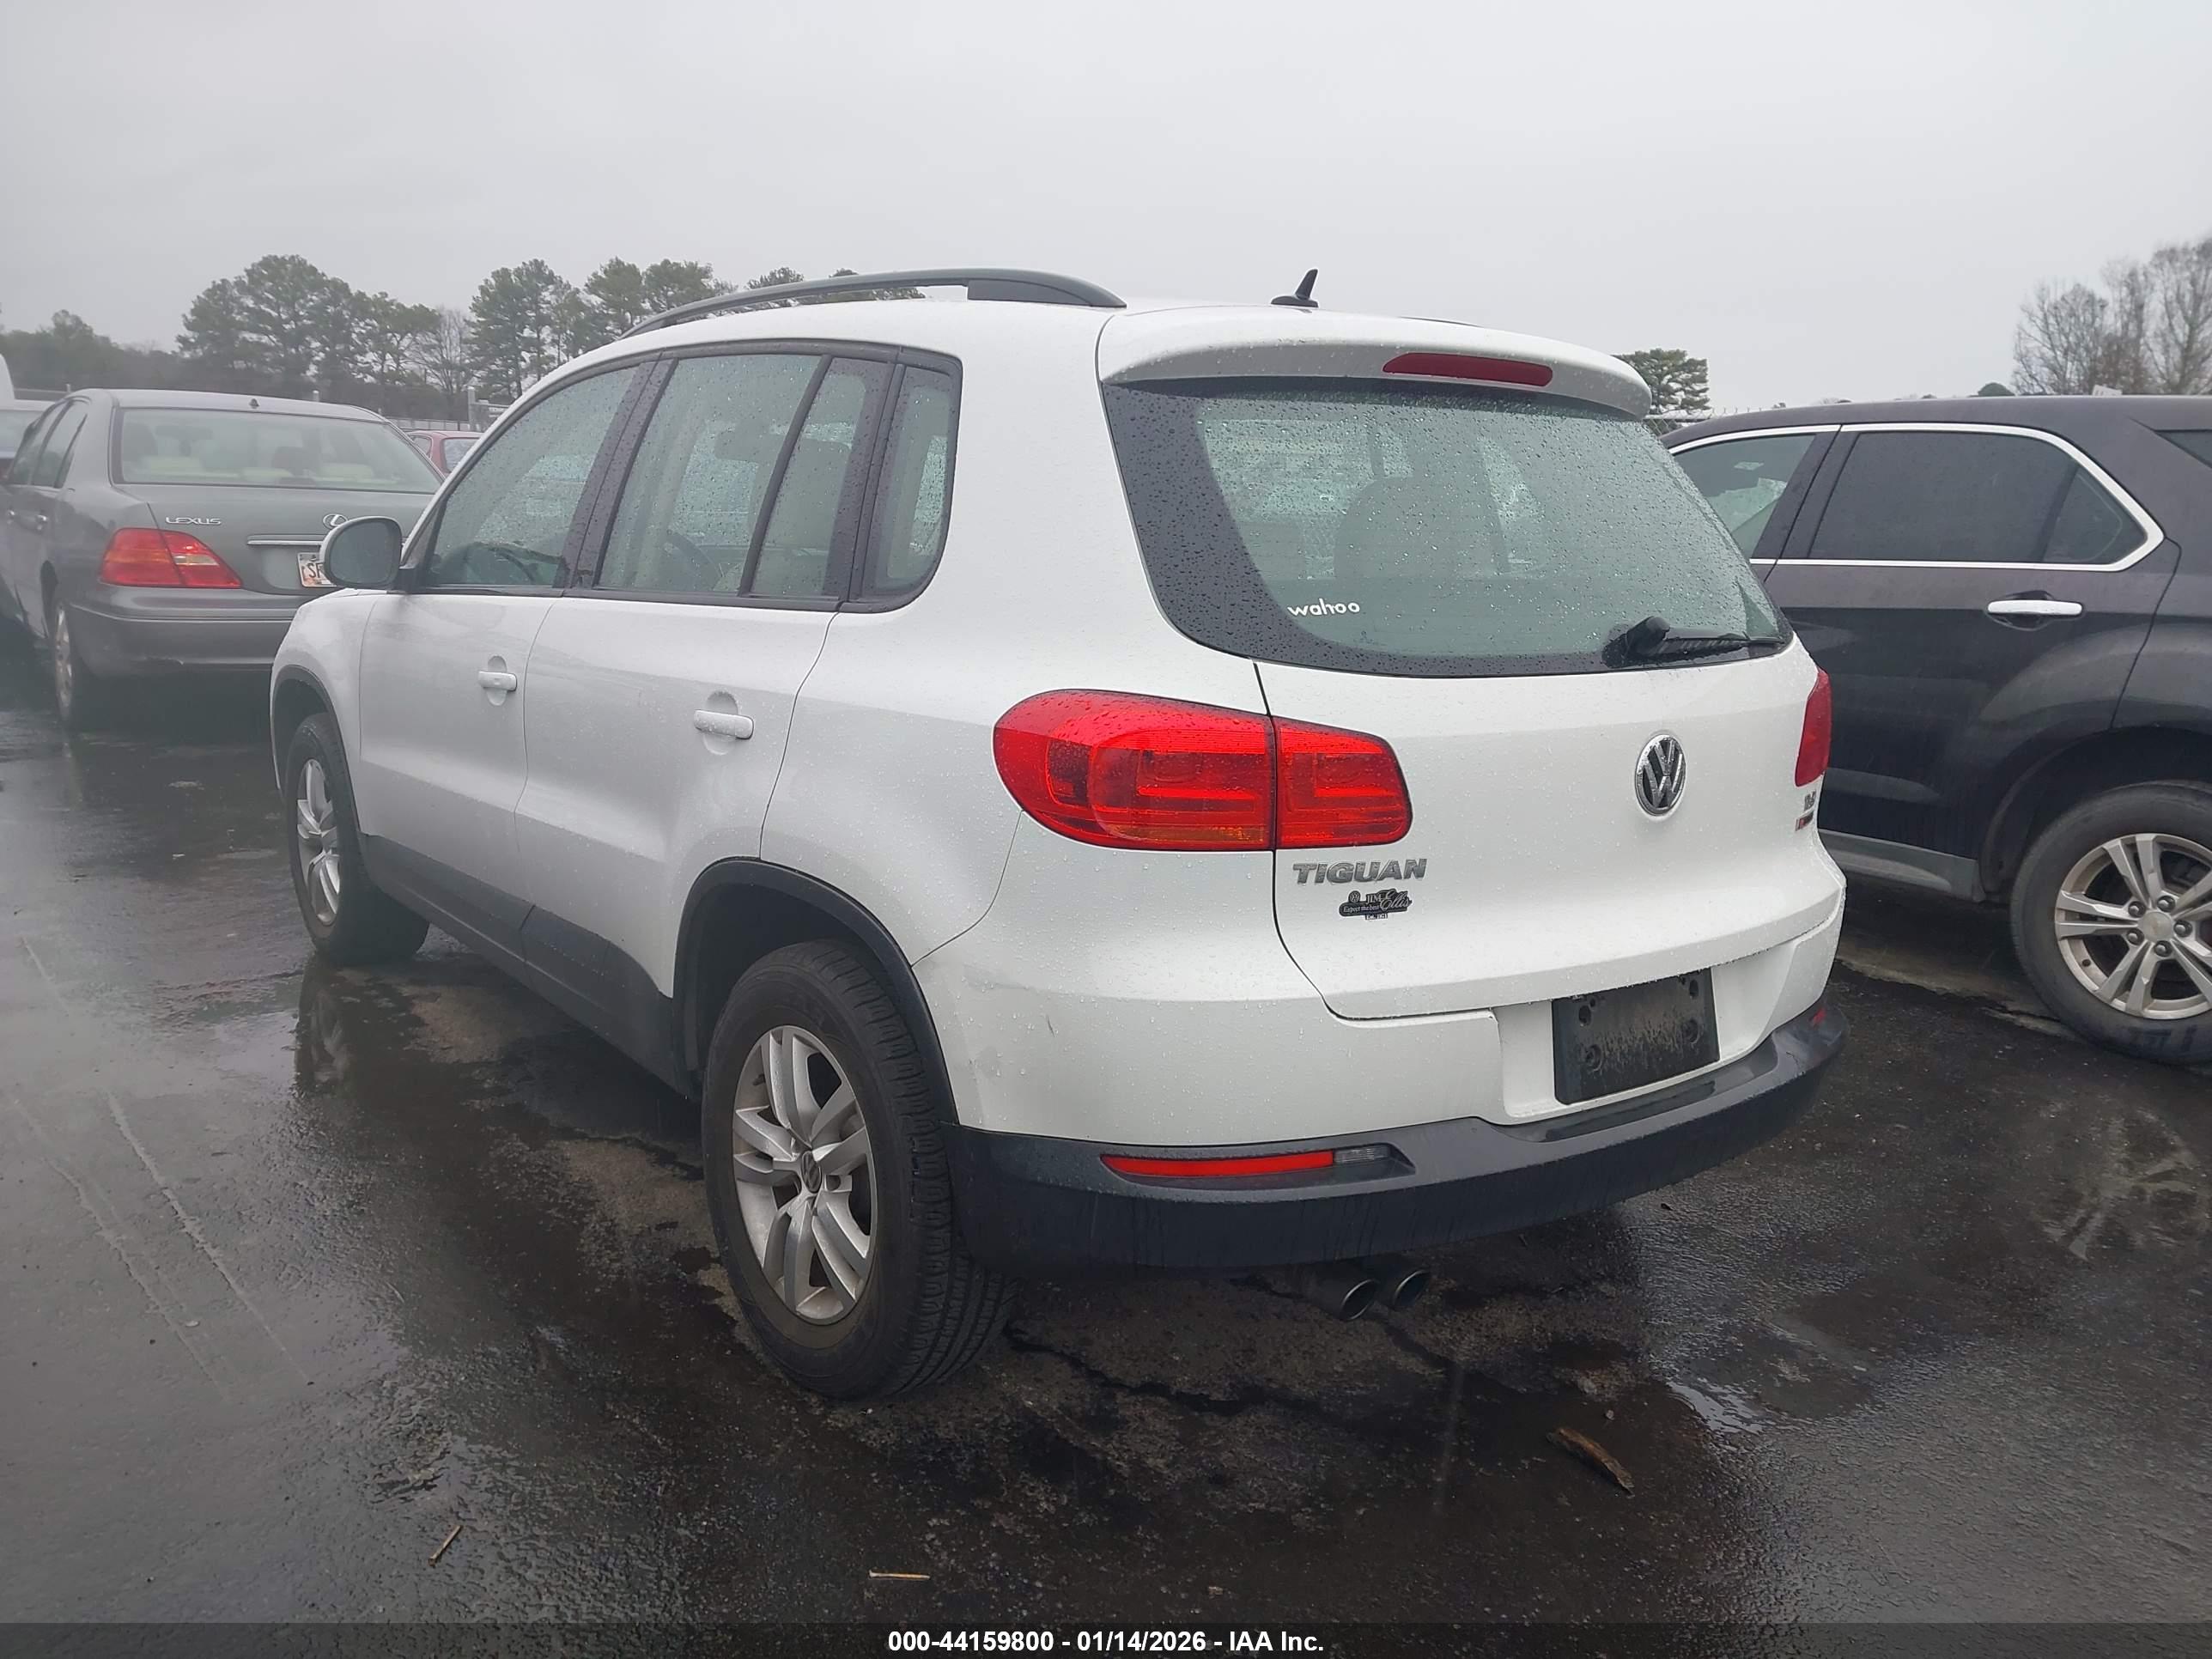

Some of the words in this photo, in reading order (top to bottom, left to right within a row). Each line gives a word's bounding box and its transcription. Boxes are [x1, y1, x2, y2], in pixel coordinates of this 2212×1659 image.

[165, 516, 222, 526] LEXUS
[1286, 598, 1360, 617] wahoo
[1292, 859, 1427, 884] TIGUAN
